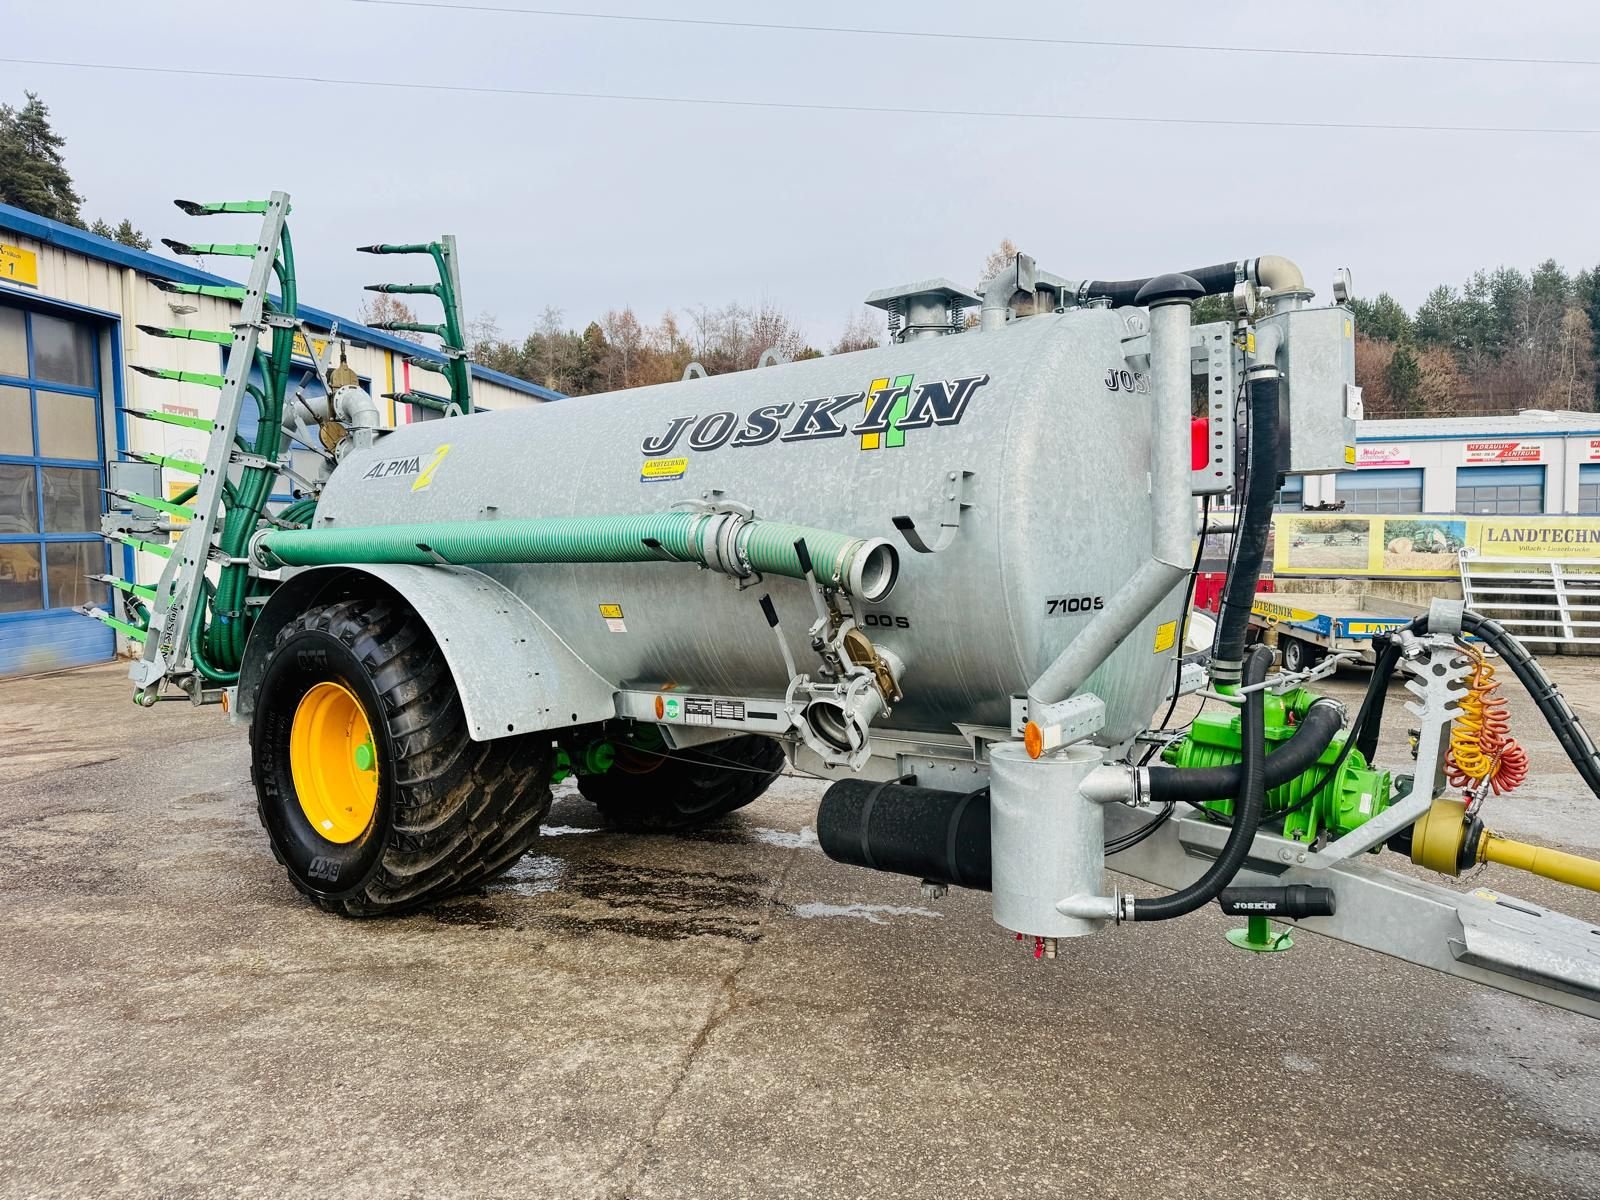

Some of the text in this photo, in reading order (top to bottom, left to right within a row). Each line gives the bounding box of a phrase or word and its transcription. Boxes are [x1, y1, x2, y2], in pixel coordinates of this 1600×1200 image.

[640, 373, 990, 456] JOSKIN
[362, 456, 420, 479] ALPINA
[1251, 599, 1293, 618] DTECHNIK
[308, 856, 341, 881] BKT
[1233, 901, 1277, 911] JOSKIN
